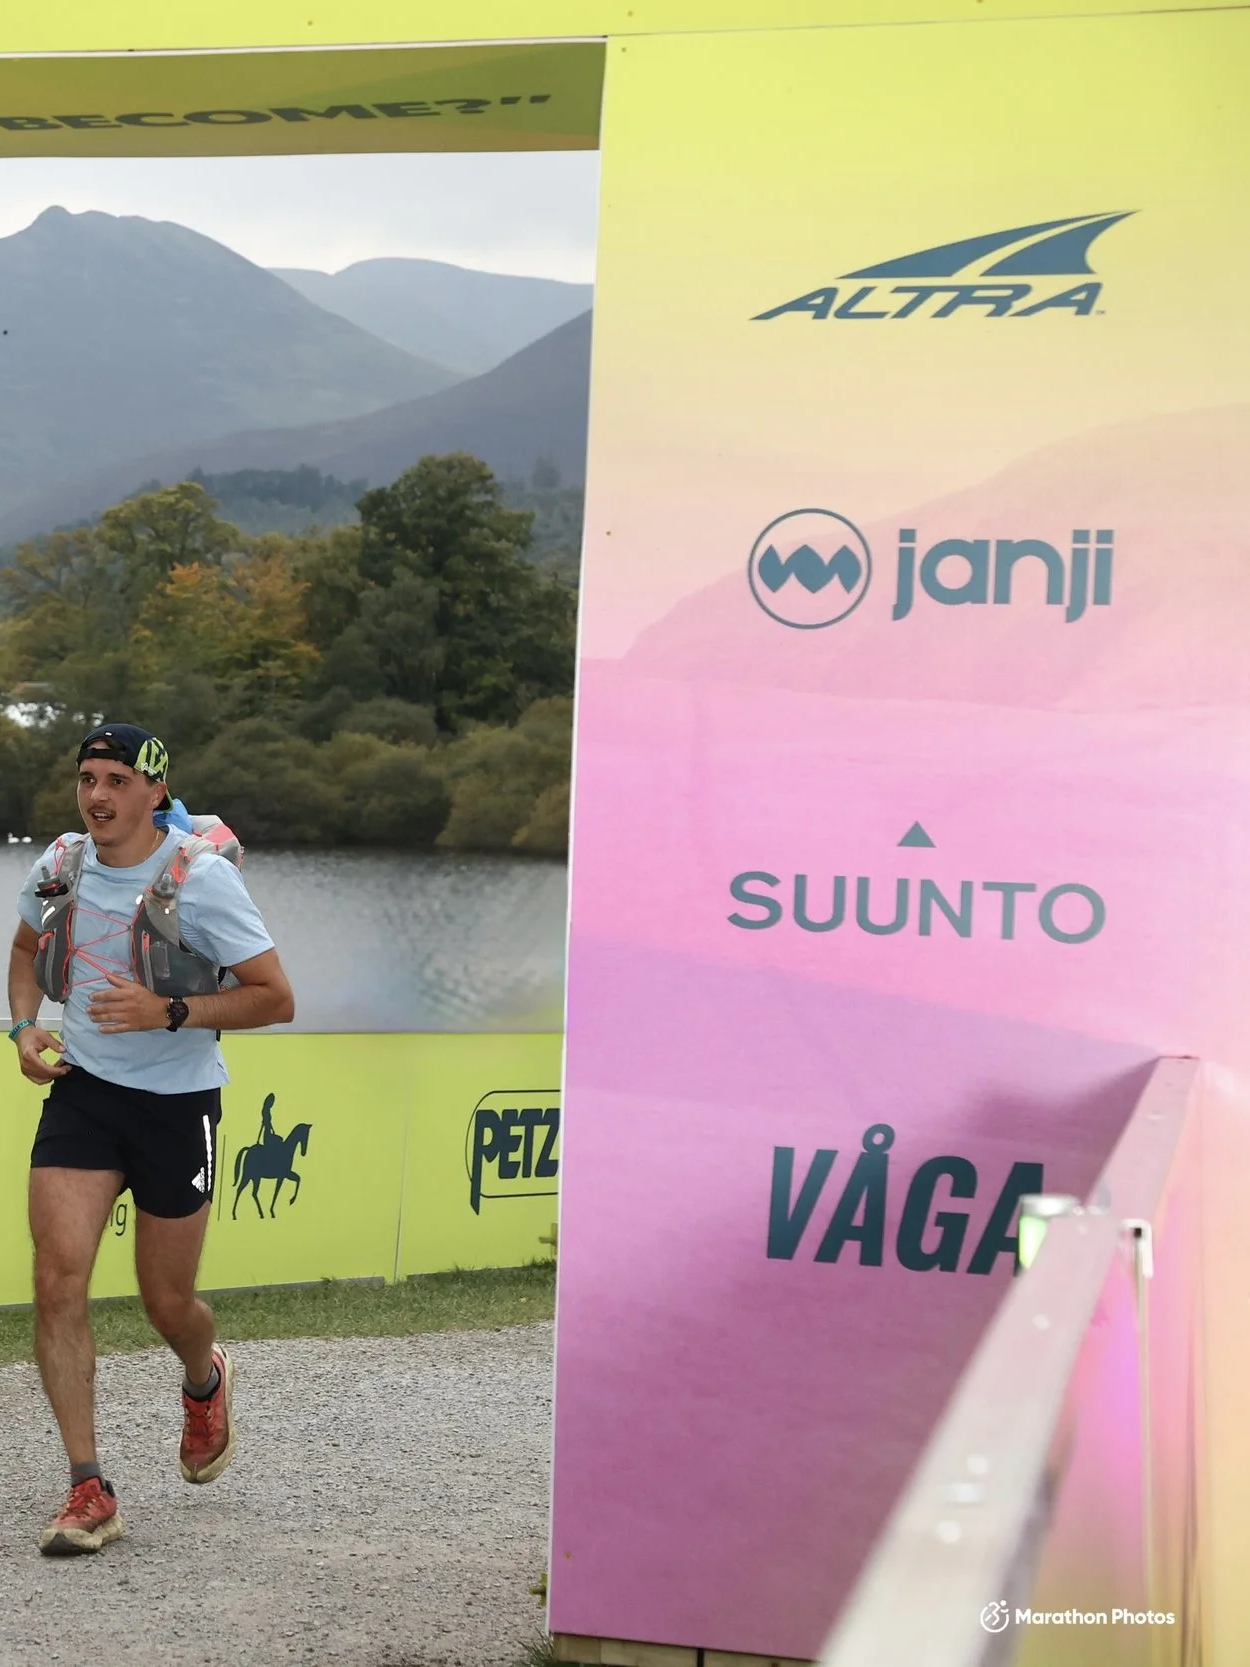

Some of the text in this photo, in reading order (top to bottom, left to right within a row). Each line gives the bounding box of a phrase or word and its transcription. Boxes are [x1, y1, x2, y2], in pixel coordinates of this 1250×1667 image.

[747, 280, 1104, 321] ALTRA
[891, 527, 1116, 624] janji
[726, 870, 1107, 945] SUUNTO
